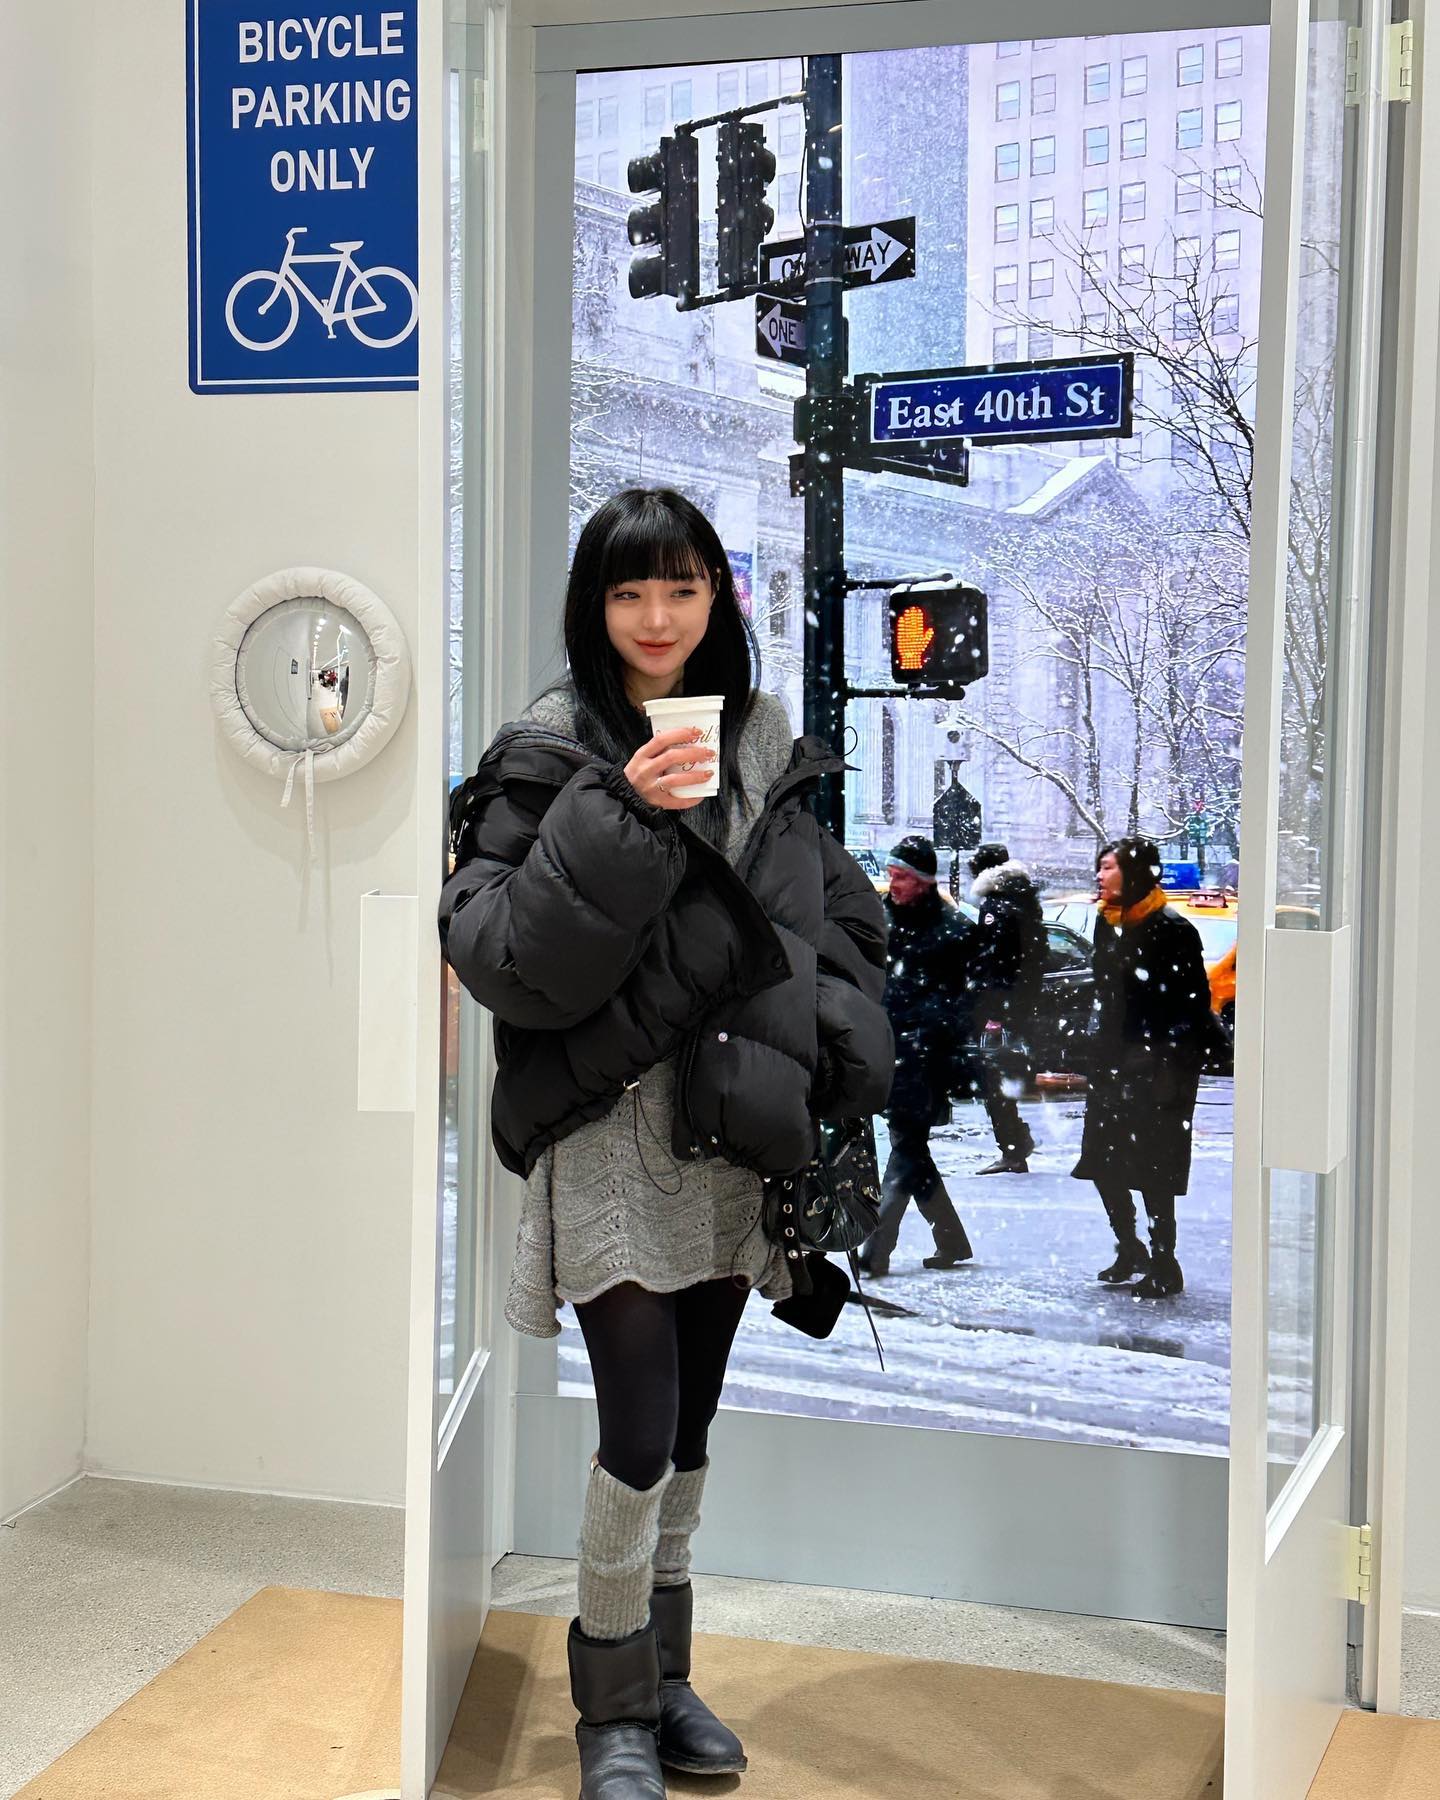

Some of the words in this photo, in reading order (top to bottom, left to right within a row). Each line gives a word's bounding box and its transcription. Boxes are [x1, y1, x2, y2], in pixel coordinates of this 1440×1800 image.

[239, 12, 404, 64] BICYCLE
[232, 79, 411, 129] PARKING
[270, 147, 375, 193] ONLY
[845, 240, 892, 270] WAY
[769, 317, 797, 345] ONE
[887, 395, 964, 430] East
[974, 386, 1054, 422] 40th
[1066, 382, 1106, 417] St
